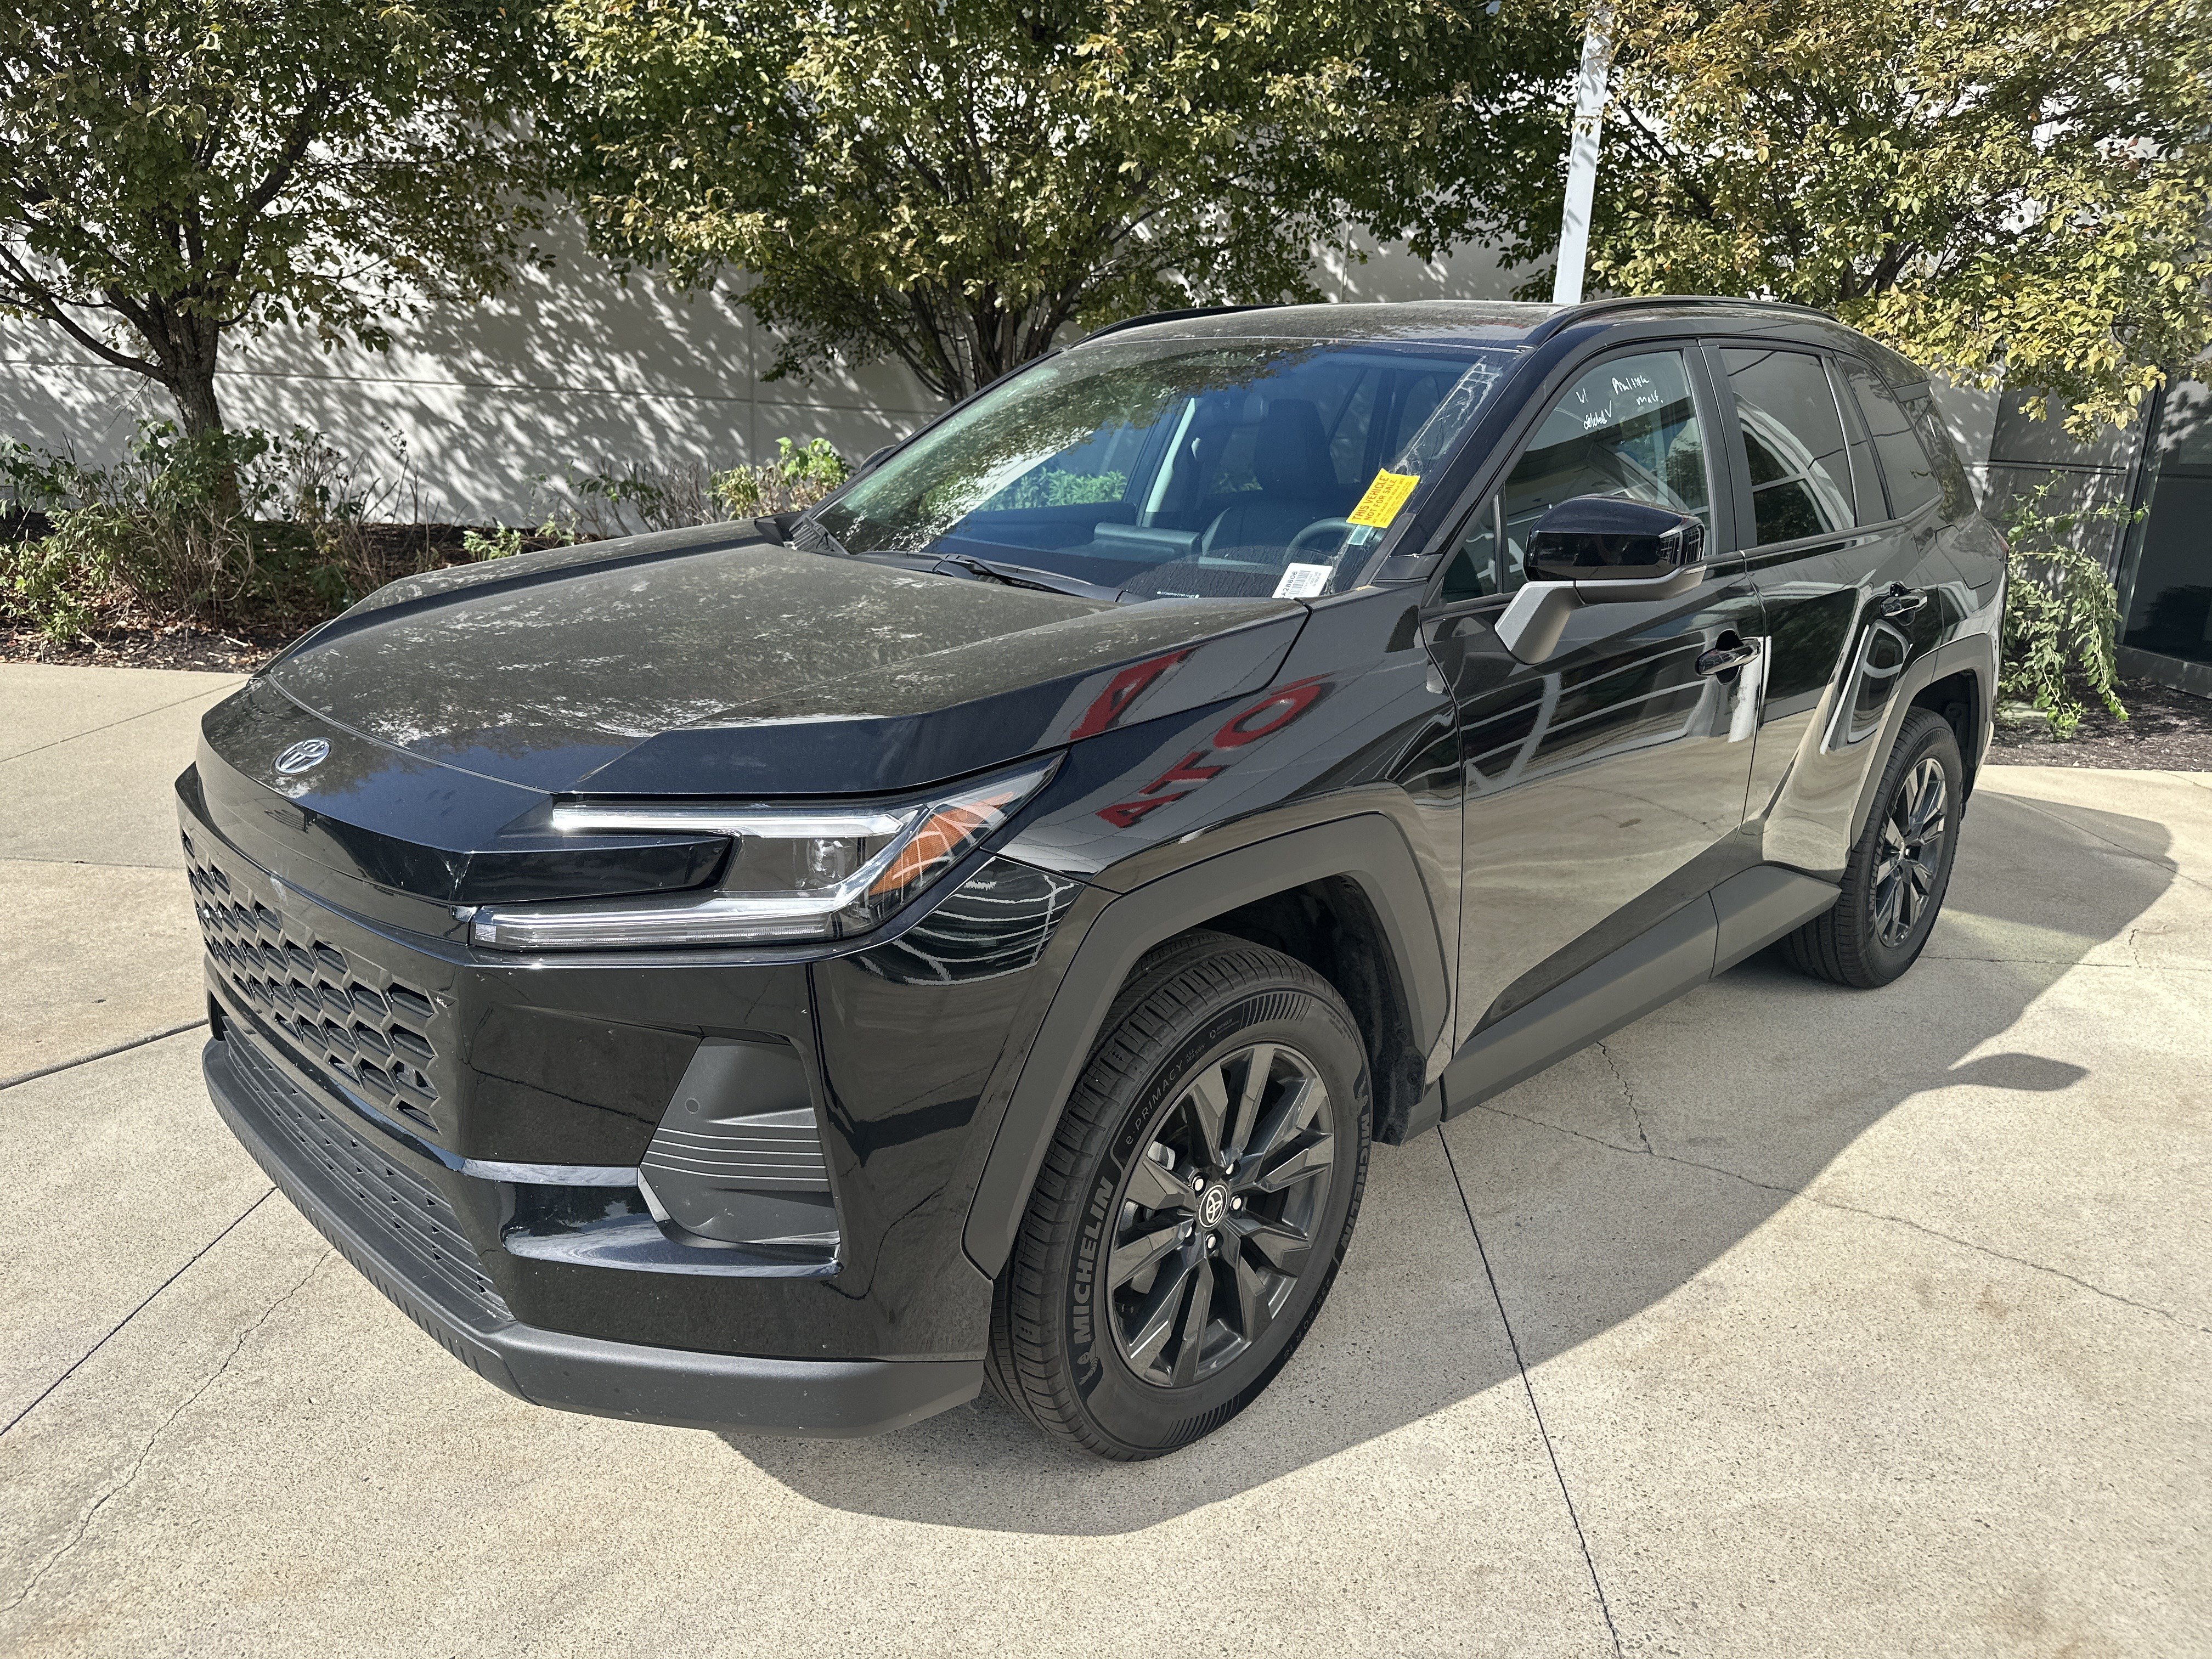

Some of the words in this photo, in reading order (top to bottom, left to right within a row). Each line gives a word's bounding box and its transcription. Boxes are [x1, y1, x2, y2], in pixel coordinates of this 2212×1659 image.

[1352, 505, 1369, 520] THIS
[1364, 475, 1389, 504] VEHICLE
[1364, 509, 1376, 521] NOT
[1374, 495, 1386, 507] FOR
[1383, 479, 1398, 494] SALE
[1868, 821, 1887, 911] MICHELIN
[1341, 1113, 1370, 1249] MICHELIN
[1073, 1176, 1114, 1344] MICHELIN
